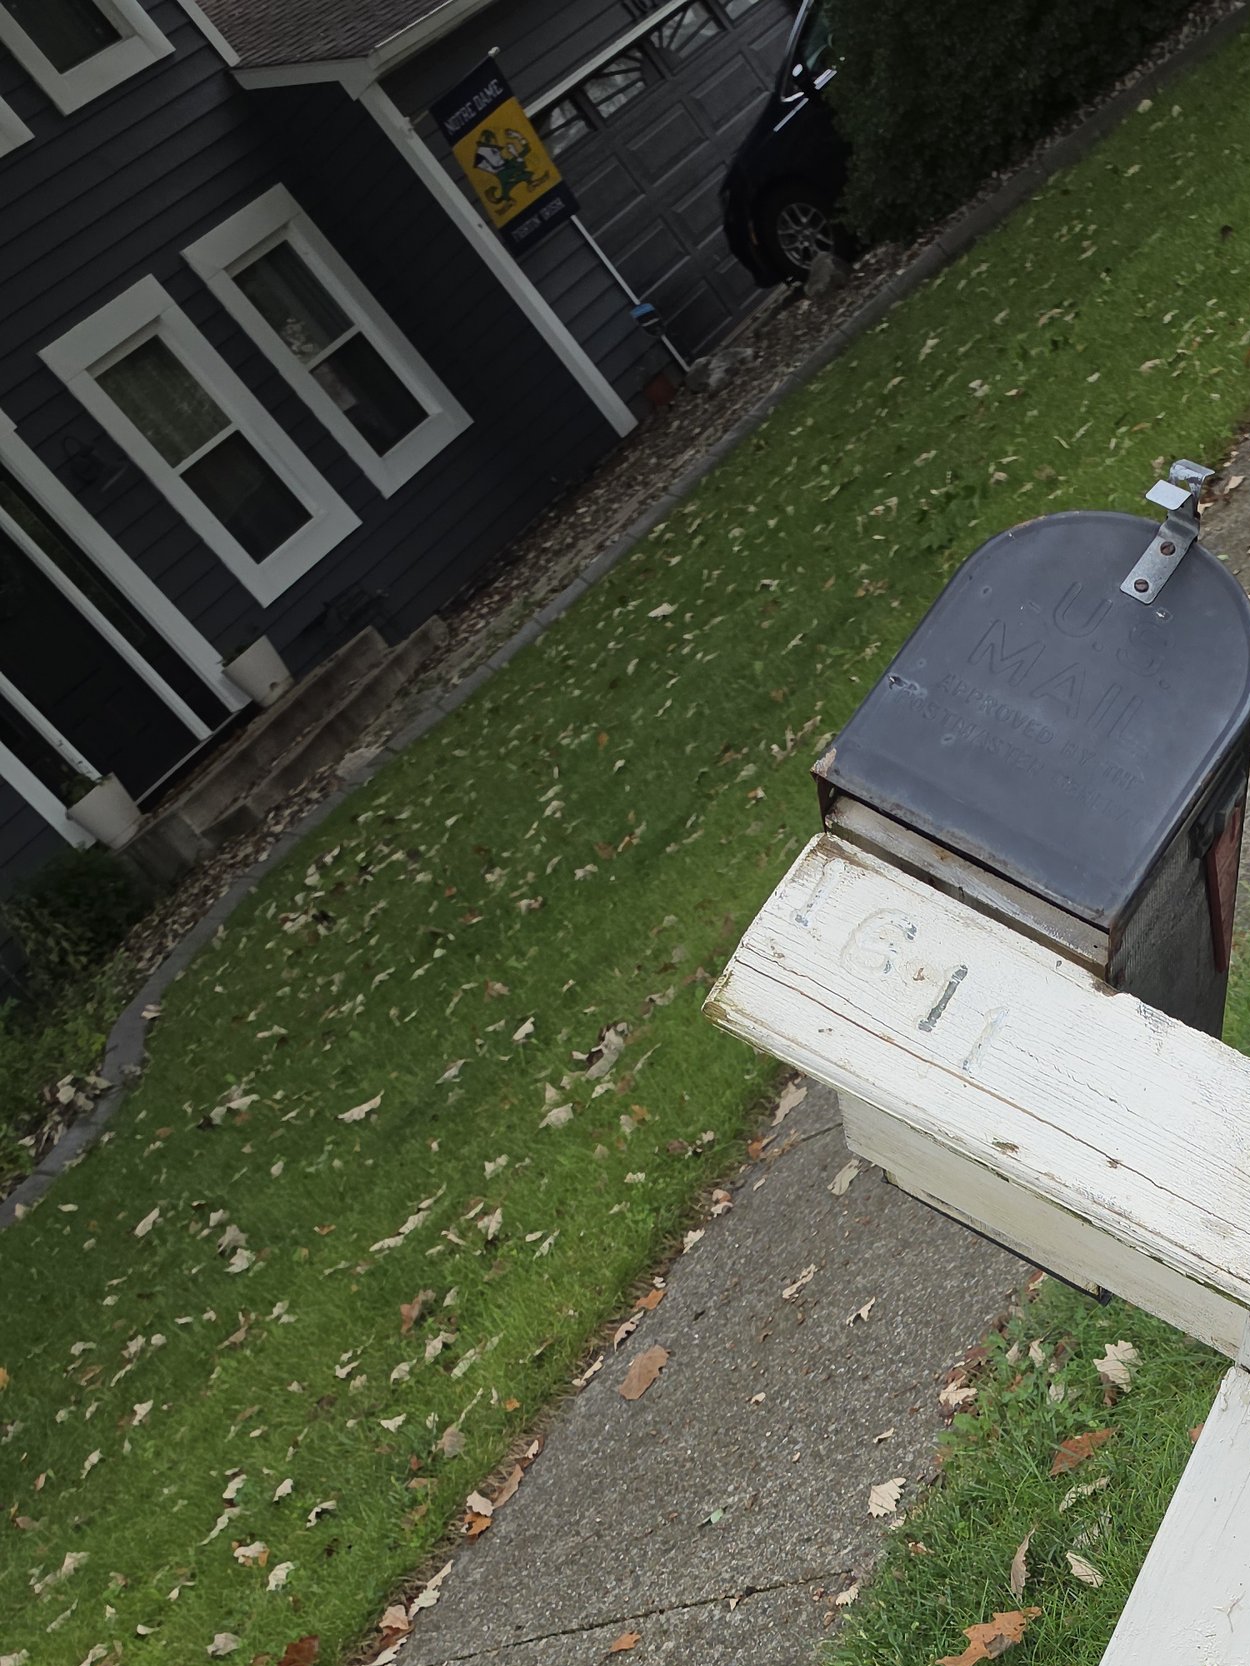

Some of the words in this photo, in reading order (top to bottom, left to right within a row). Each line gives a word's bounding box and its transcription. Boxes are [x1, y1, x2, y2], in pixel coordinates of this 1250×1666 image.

[444, 102, 477, 135] NOTRE
[473, 78, 504, 111] DAME
[935, 671, 1055, 746] APPROVED
[966, 617, 1155, 757] MAIL
[896, 690, 1047, 778] POSTMASTER
[1059, 739, 1098, 769] BY
